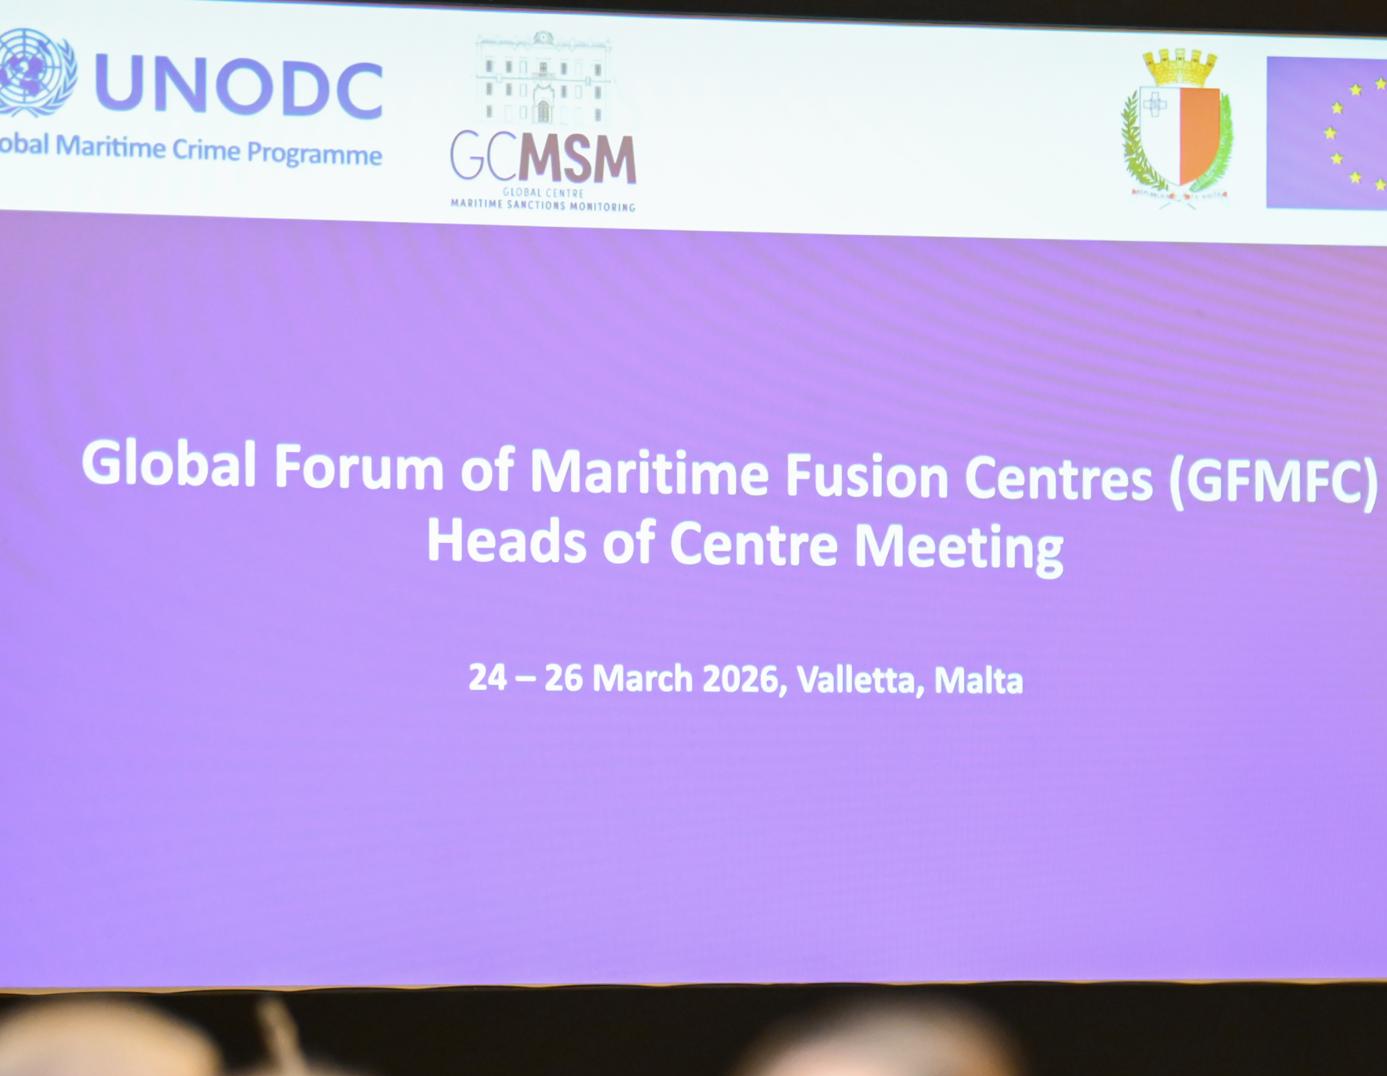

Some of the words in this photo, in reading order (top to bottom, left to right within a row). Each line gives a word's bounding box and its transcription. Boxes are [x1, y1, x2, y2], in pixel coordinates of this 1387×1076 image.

[95, 53, 383, 120] UNODC
[0, 131, 49, 155] obal
[56, 134, 167, 159] Maritime
[172, 138, 241, 162] Crime
[247, 141, 383, 169] Programme
[450, 129, 637, 184] GCMSM
[450, 198, 503, 209] MARITIME
[506, 199, 566, 211] SANCTIONS
[569, 201, 636, 213] MONITORING
[502, 186, 541, 198] GLOBAL
[545, 187, 584, 199] CENTRE
[82, 437, 256, 488] Global
[276, 443, 444, 491] Forum
[461, 444, 516, 492] of
[531, 448, 769, 497] Maritime
[787, 452, 948, 499] Fusion
[965, 455, 1154, 502] Centres
[1169, 454, 1379, 514] (GFMFC)
[428, 516, 587, 564] Heads
[603, 517, 657, 565] of
[670, 520, 838, 567] Centre
[856, 522, 1065, 580] Meeting
[468, 662, 508, 691] 24
[544, 663, 584, 692] 26
[593, 662, 693, 693] March
[703, 664, 788, 699] 2026,
[796, 663, 925, 699] Valletta,
[935, 664, 1024, 695] Malta
